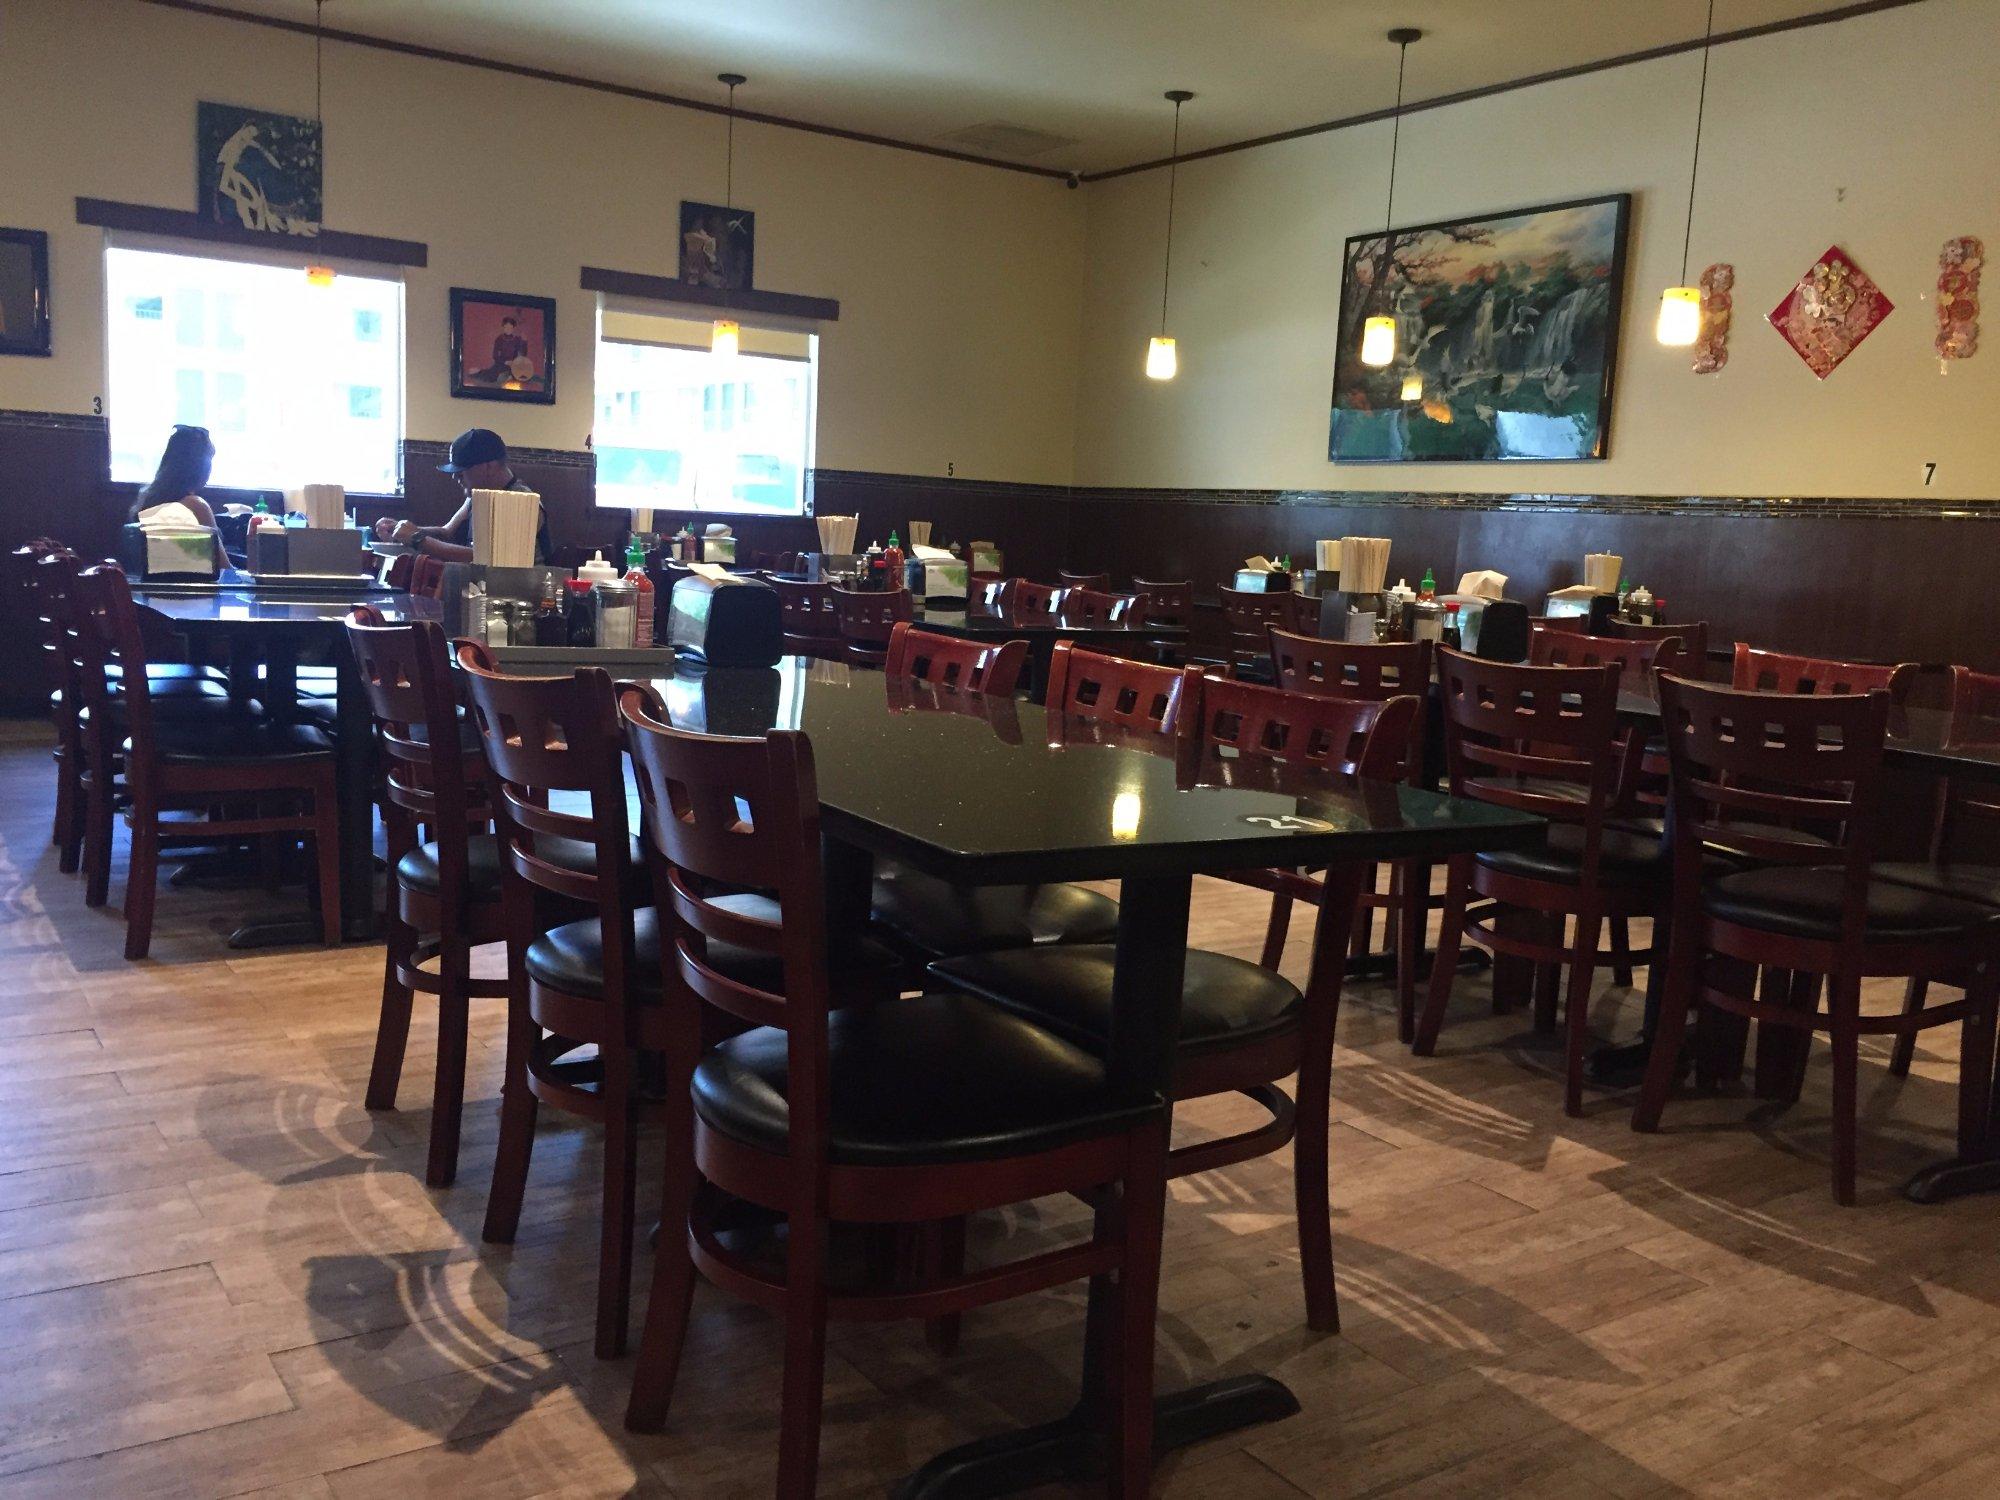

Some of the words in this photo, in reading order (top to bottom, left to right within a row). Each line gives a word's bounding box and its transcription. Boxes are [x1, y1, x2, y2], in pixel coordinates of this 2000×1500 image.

[93, 396, 102, 415] 3
[584, 433, 592, 450] 4
[947, 462, 954, 477] 5
[1924, 462, 1937, 486] 7
